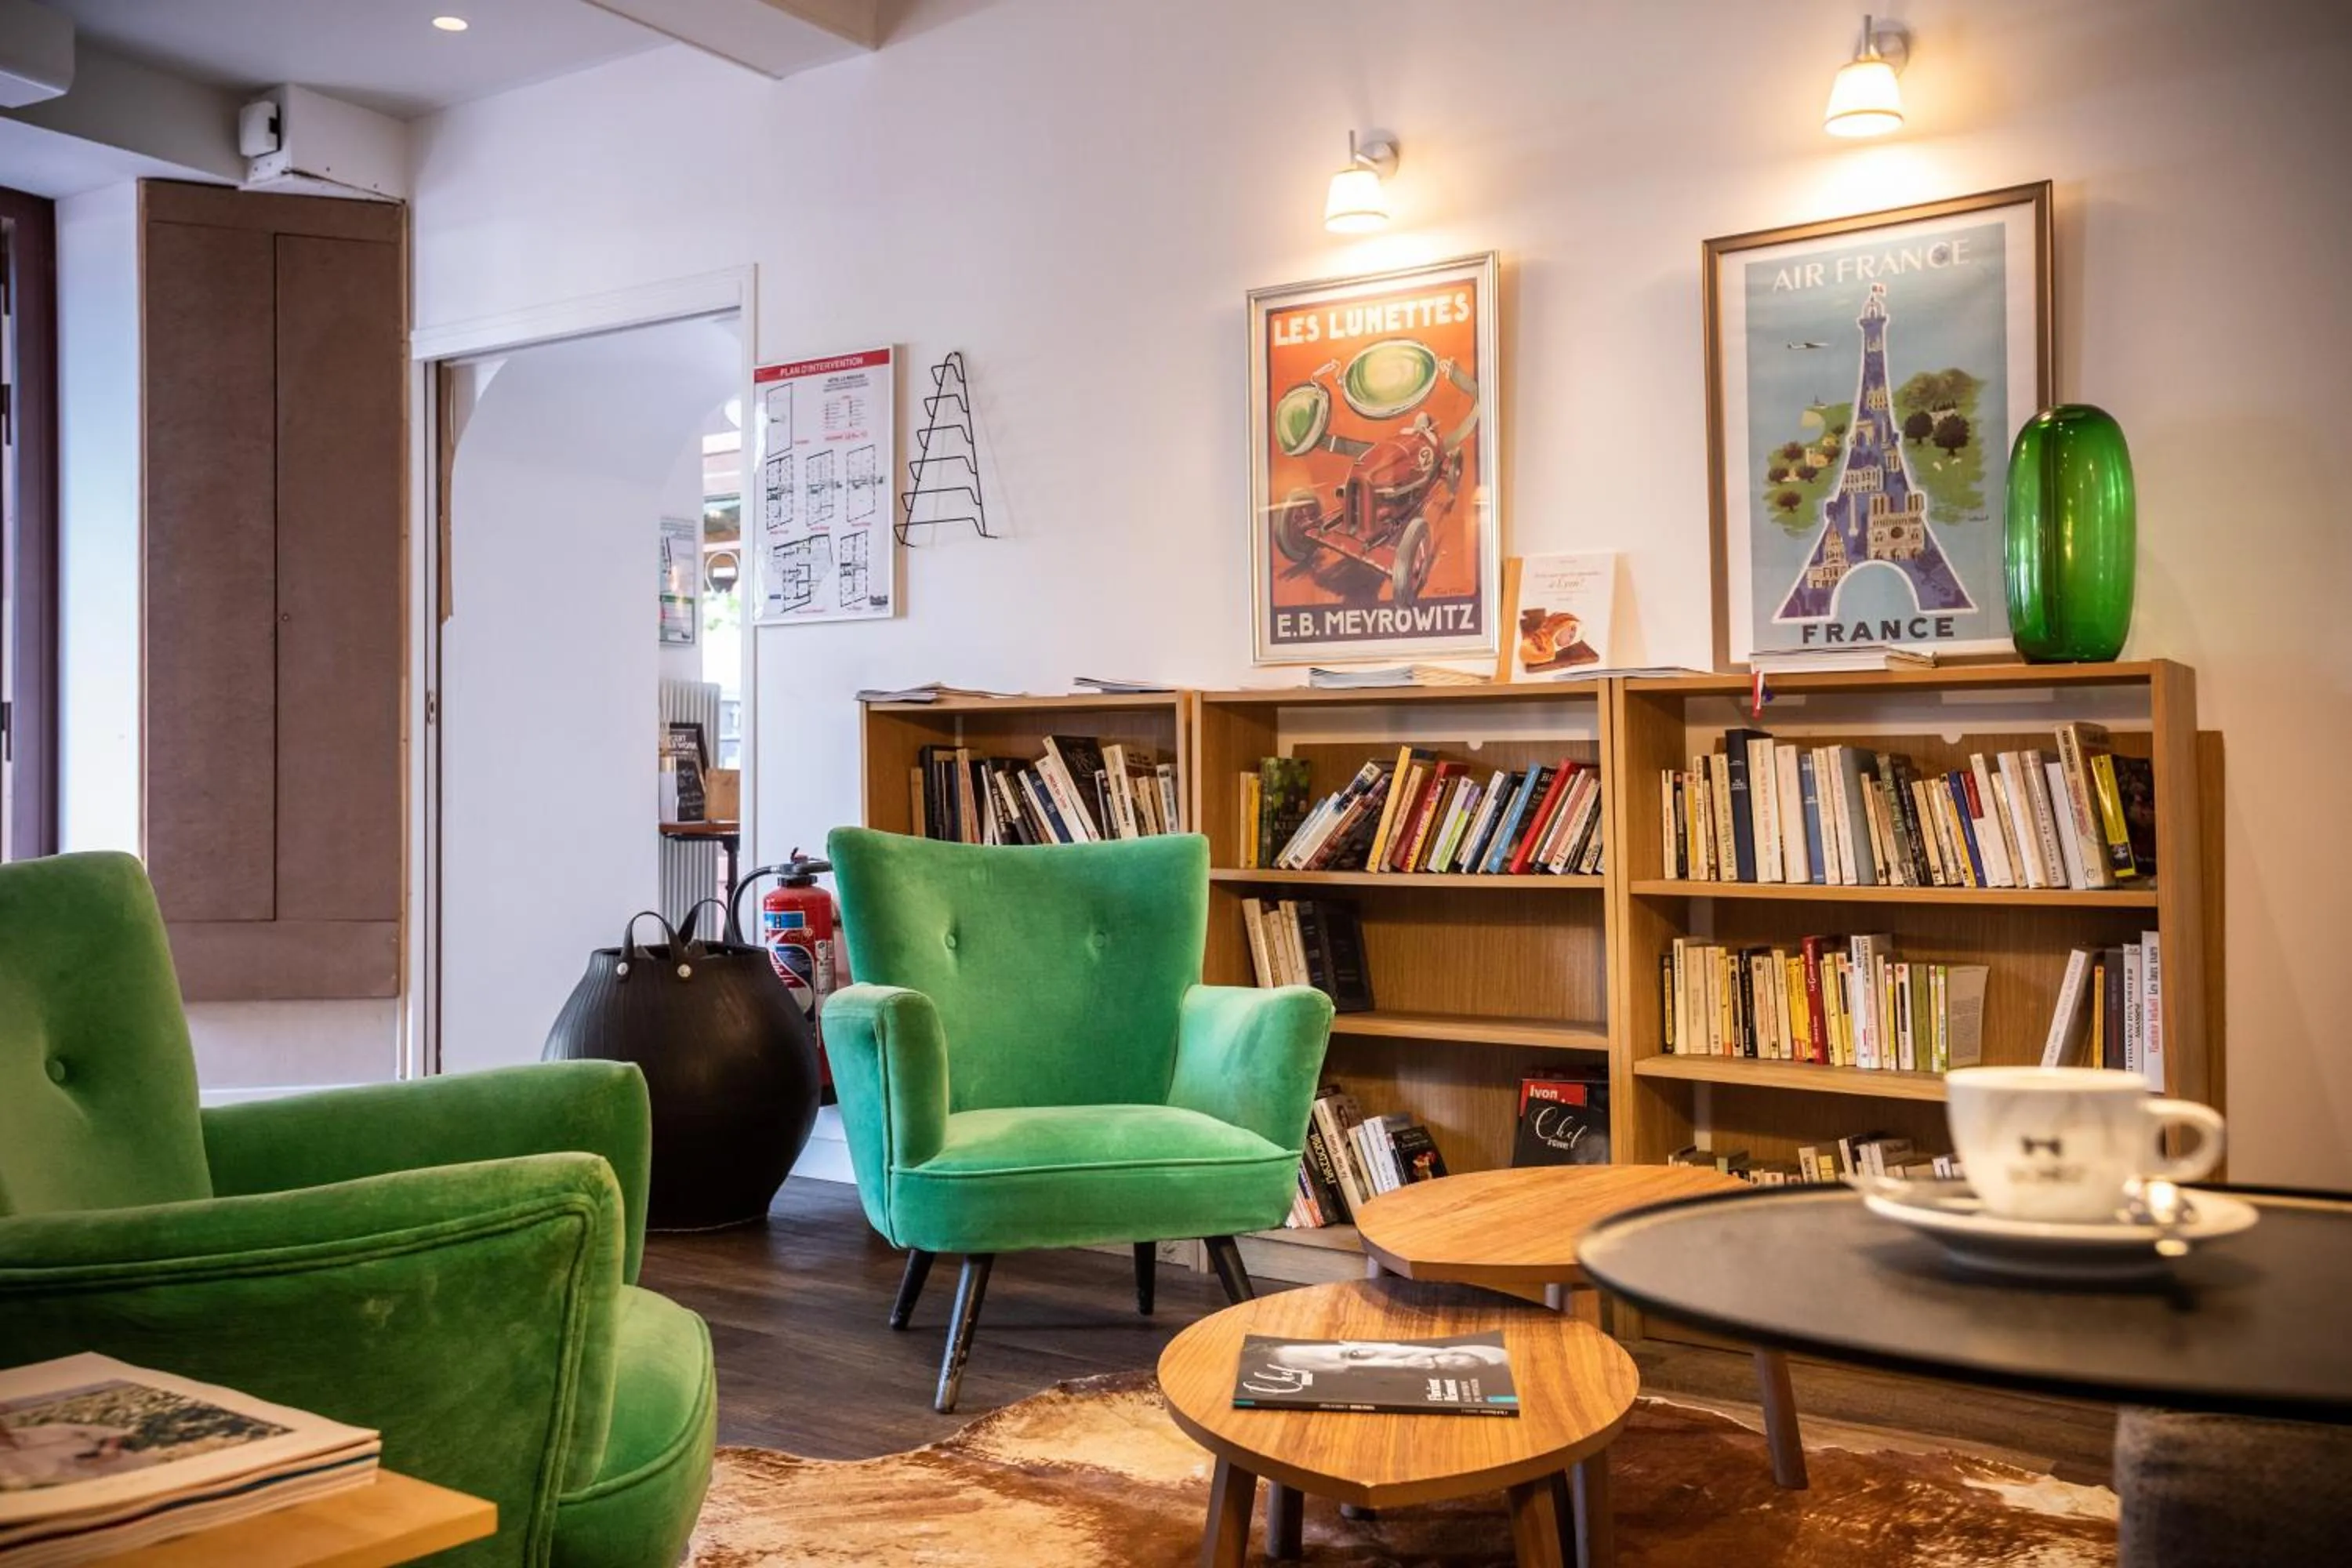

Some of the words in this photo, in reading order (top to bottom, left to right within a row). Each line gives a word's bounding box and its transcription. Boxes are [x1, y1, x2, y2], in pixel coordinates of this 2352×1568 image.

[1773, 262, 1825, 293] AIR
[1835, 238, 1970, 283] FRANCE
[1273, 315, 1320, 346] LES
[1329, 292, 1470, 339] LUNETTES
[780, 366, 800, 377] PLAN
[1277, 612, 1320, 637] E.B.
[1325, 604, 1475, 635] MEYROWITZ
[1801, 617, 1955, 644] FRANCE
